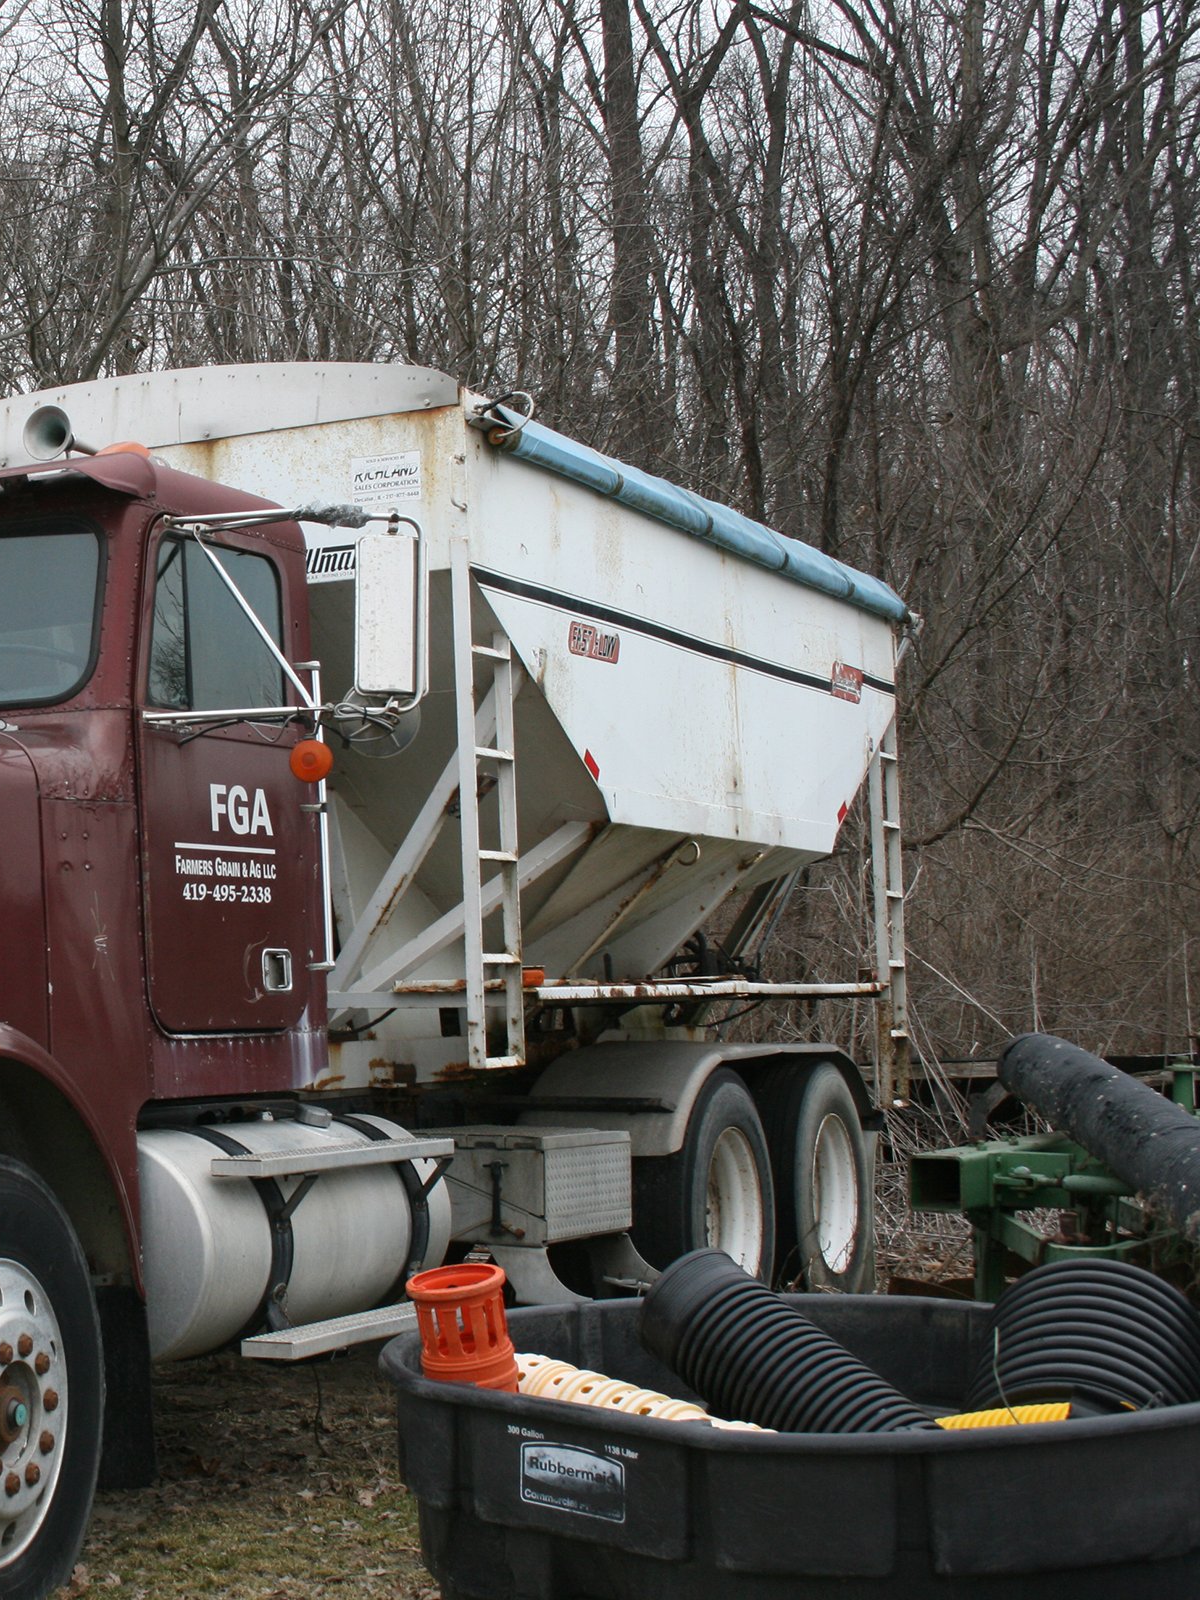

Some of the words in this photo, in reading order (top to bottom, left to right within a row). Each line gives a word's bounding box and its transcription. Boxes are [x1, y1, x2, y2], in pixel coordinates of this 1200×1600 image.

[354, 484, 372, 492] SALES
[372, 478, 418, 490] CORPORATION
[571, 625, 592, 654] FAST
[210, 783, 274, 836] FGA
[242, 862, 248, 878] &
[262, 864, 276, 880] LLC
[182, 882, 272, 904] 419-495-2338
[507, 1424, 520, 1435] 300
[521, 1426, 544, 1440] Gallon
[528, 1455, 616, 1487] Rubbermaid
